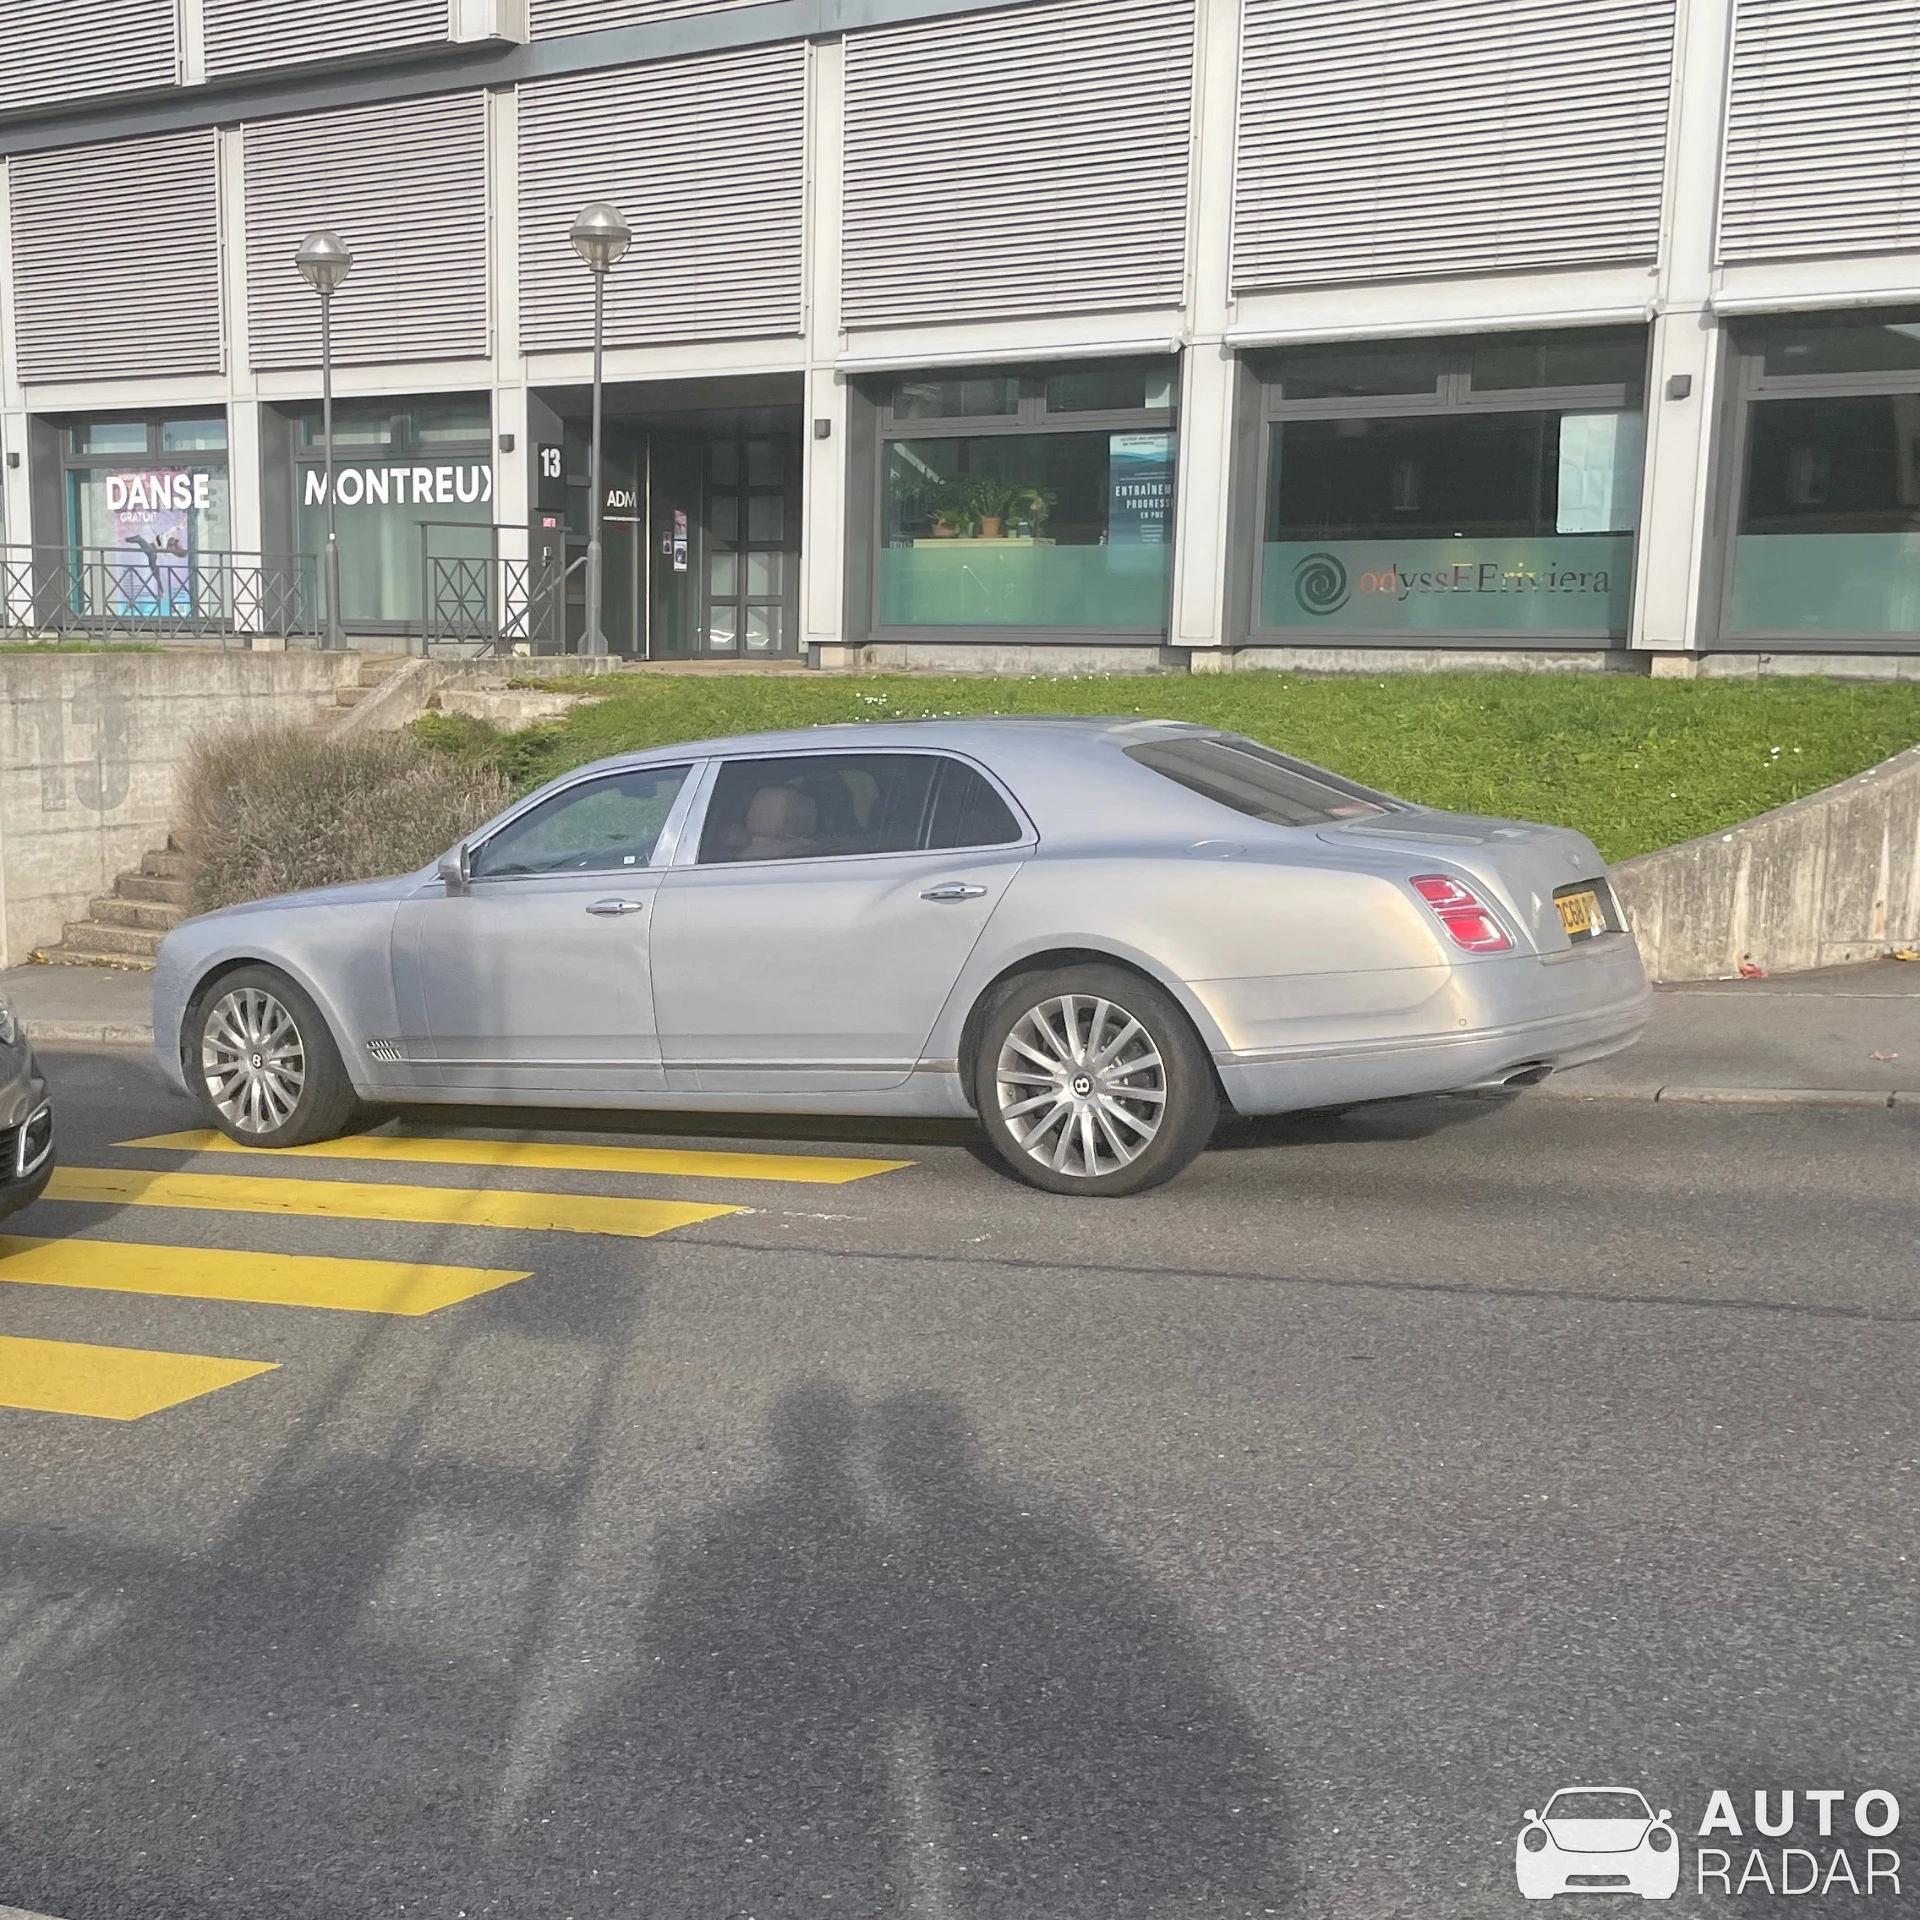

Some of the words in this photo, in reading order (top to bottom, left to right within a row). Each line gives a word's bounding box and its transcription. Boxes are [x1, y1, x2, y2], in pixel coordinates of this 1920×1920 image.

[540, 448, 561, 478] 13
[106, 473, 210, 510] DANSE
[304, 465, 492, 506] MONTREUX
[607, 490, 637, 508] ADM
